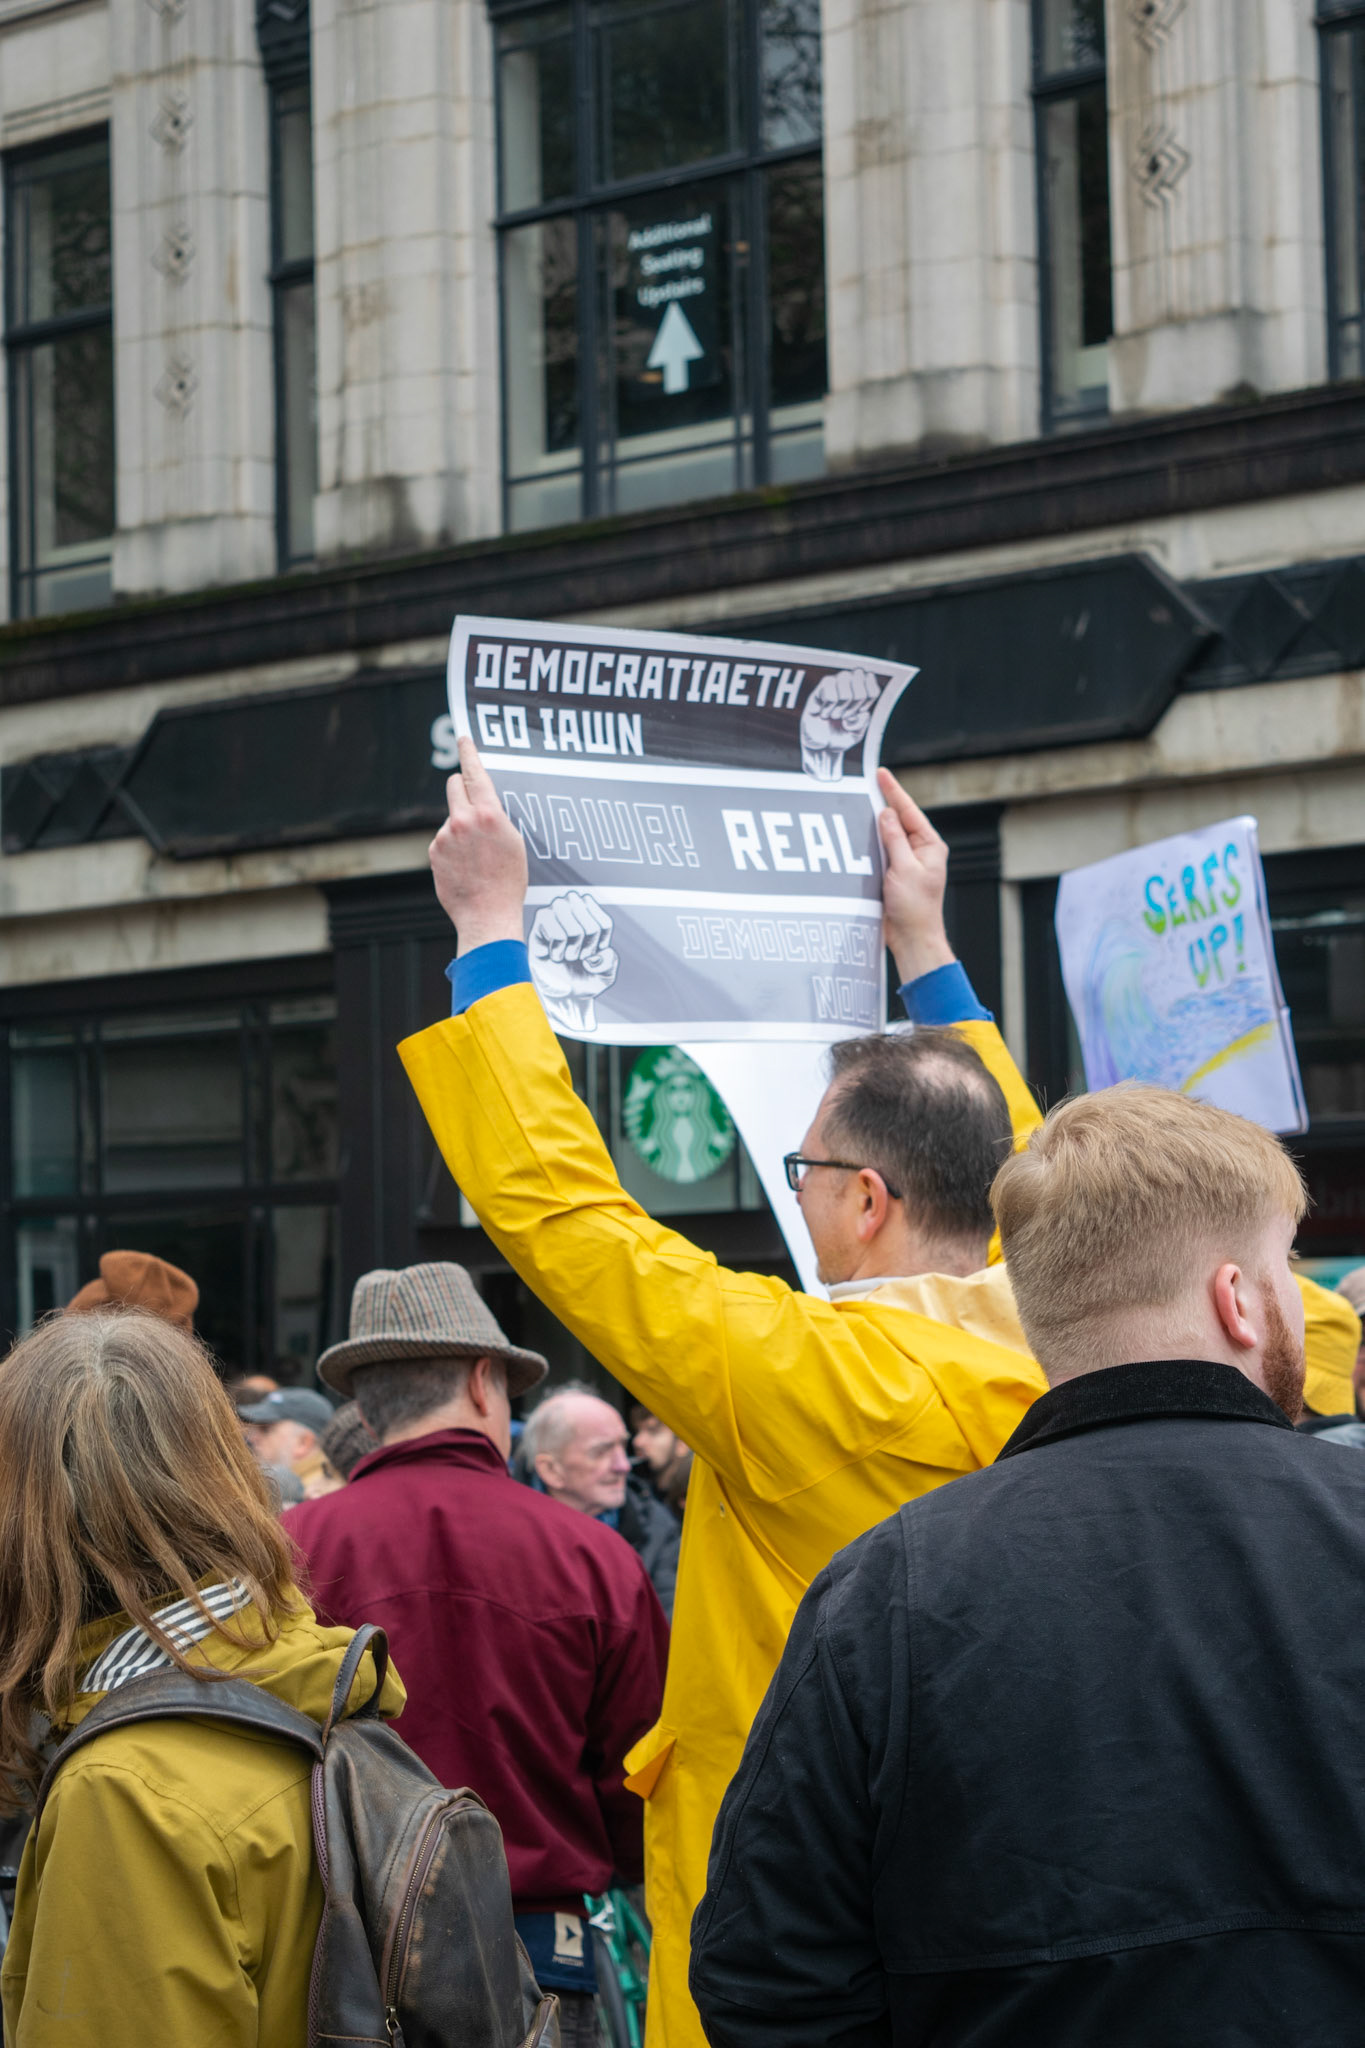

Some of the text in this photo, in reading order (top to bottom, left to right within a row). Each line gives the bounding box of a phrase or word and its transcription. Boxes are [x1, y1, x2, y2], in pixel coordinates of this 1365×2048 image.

[474, 643, 805, 709] DEMOCRATIAETH
[475, 703, 644, 756] GO IAWN
[503, 791, 700, 868] NAWR!
[721, 809, 873, 875] REAL
[1188, 914, 1246, 988] UP!
